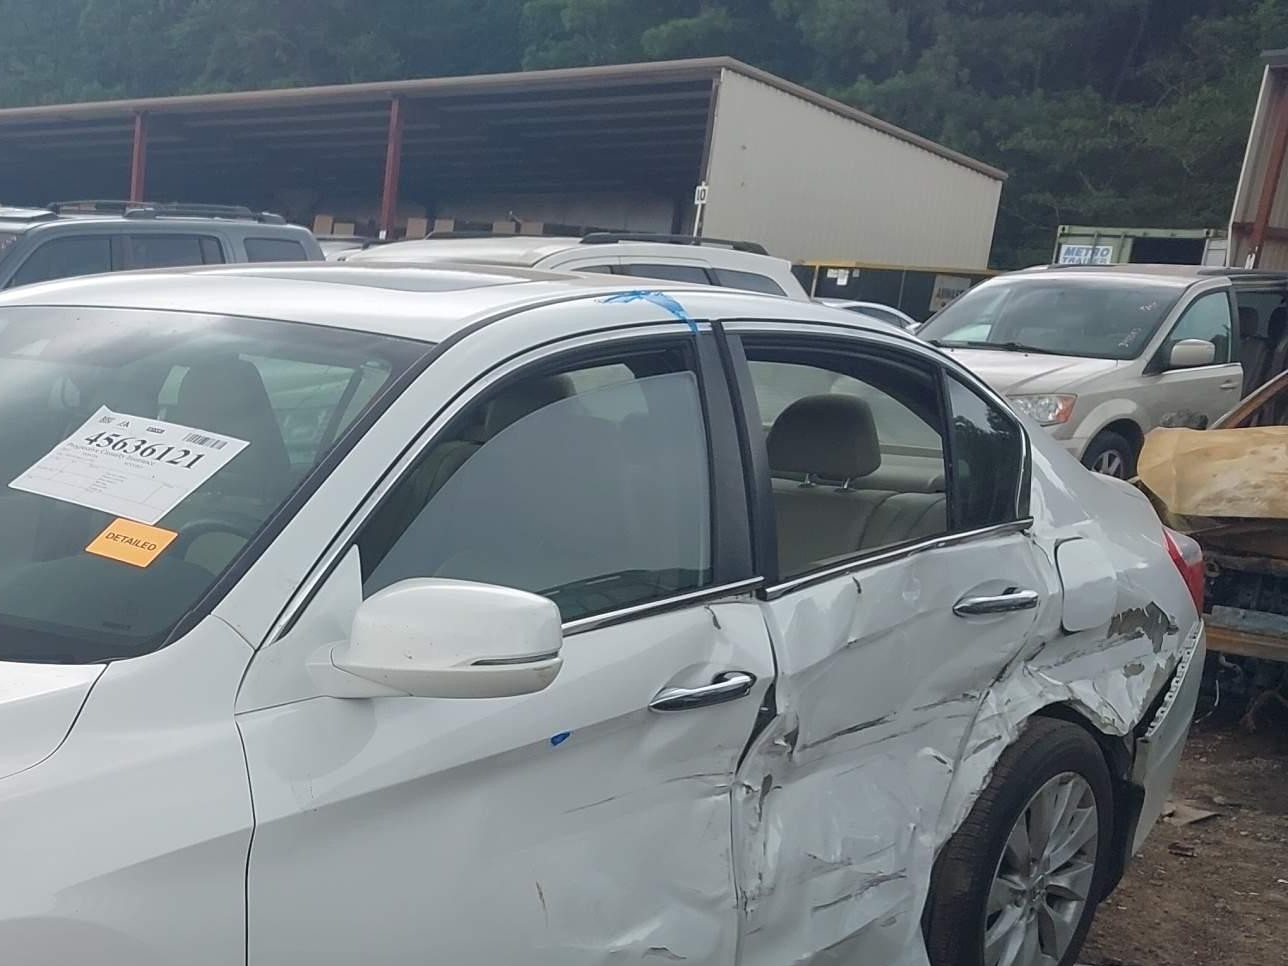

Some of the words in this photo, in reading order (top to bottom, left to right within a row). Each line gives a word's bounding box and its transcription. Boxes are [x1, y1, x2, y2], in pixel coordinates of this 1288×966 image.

[697, 189, 706, 201] 10
[1064, 247, 1110, 257] METRO
[85, 431, 205, 469] 45636121
[105, 531, 157, 551] DETAILED
